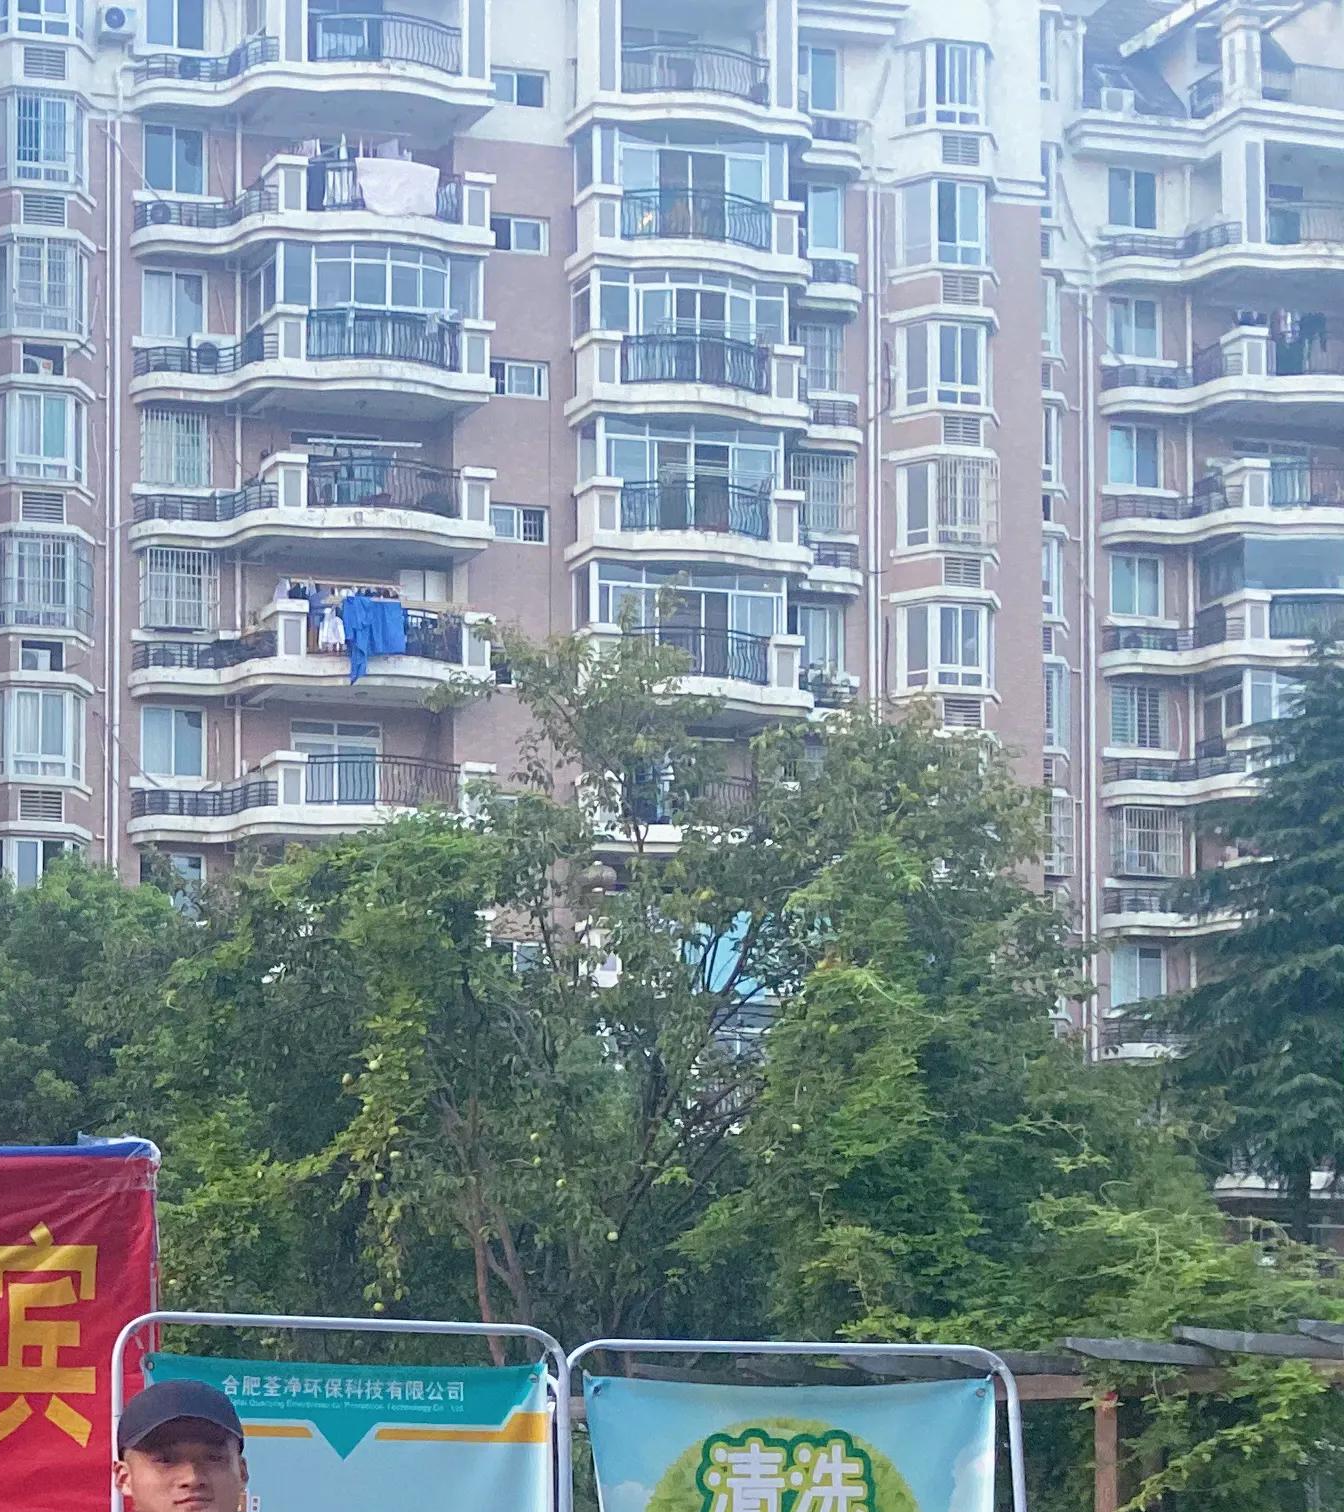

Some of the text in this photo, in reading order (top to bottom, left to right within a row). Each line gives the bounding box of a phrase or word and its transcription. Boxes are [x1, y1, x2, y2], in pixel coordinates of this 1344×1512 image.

[222, 1374, 465, 1402] 合肥荃净环保科技有限公司
